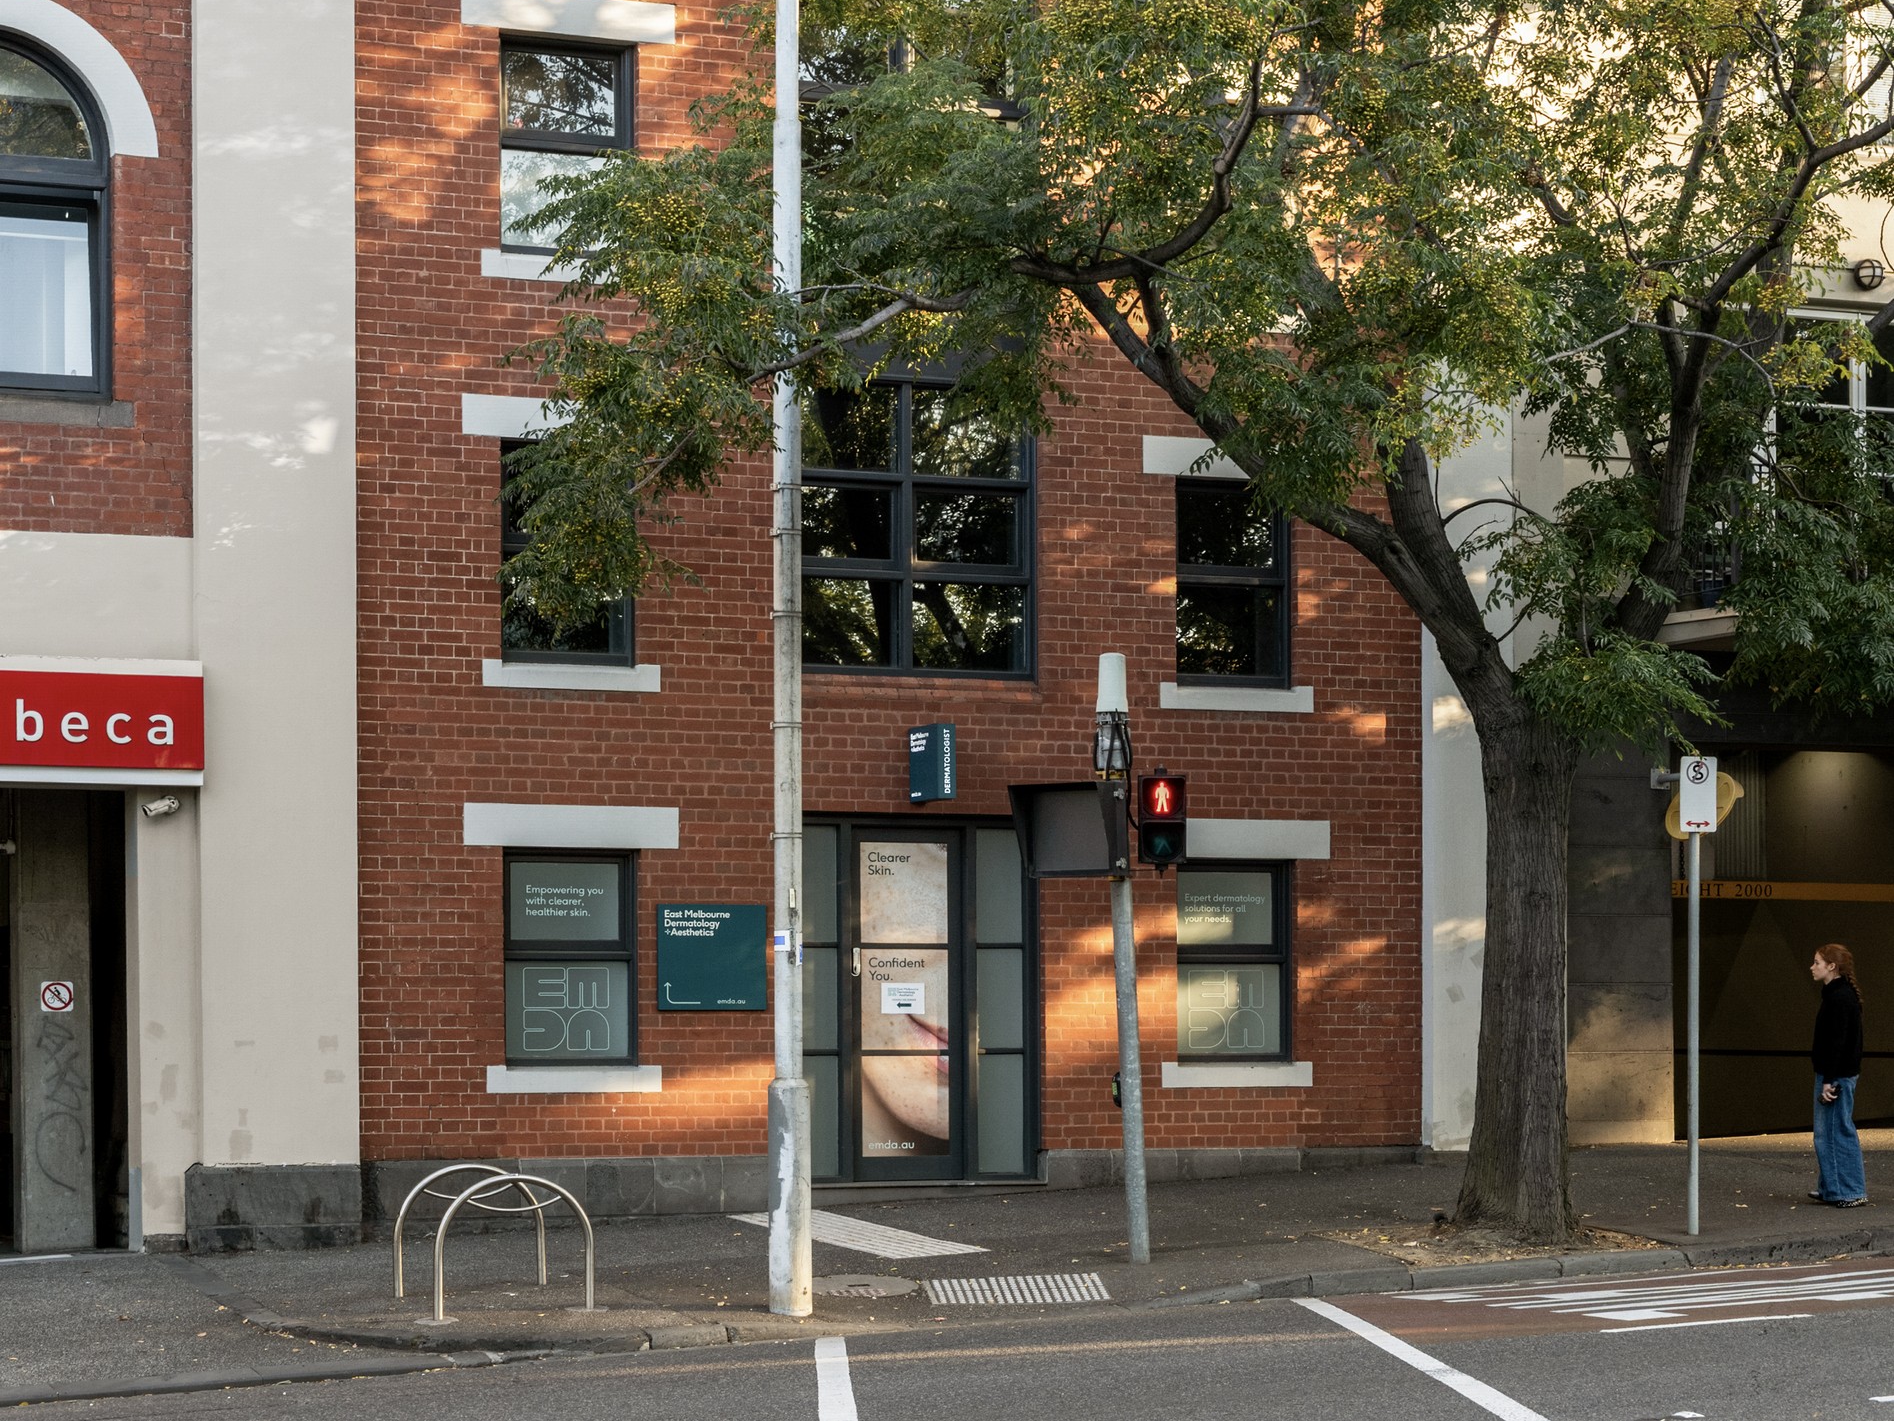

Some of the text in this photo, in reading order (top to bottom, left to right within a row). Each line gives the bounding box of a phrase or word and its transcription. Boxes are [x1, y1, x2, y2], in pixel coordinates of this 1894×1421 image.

[15, 698, 174, 745] beca
[943, 728, 951, 794] DERMATOLOGIST
[867, 851, 911, 863] Clearer
[867, 864, 895, 876] Skin.
[525, 884, 604, 897] Empowering you
[1735, 883, 1773, 898] 2000
[525, 896, 585, 907] with clearer,
[1184, 893, 1266, 905] Expert dermatology
[525, 907, 591, 917] healthier skin.
[664, 909, 731, 919] East Melbourne
[1184, 904, 1247, 913] solutions for all
[664, 919, 720, 930] Dermatology
[1184, 915, 1232, 925] your needs.
[868, 957, 925, 968] Confident
[868, 970, 894, 981] You.
[868, 1139, 915, 1150] emda.au
